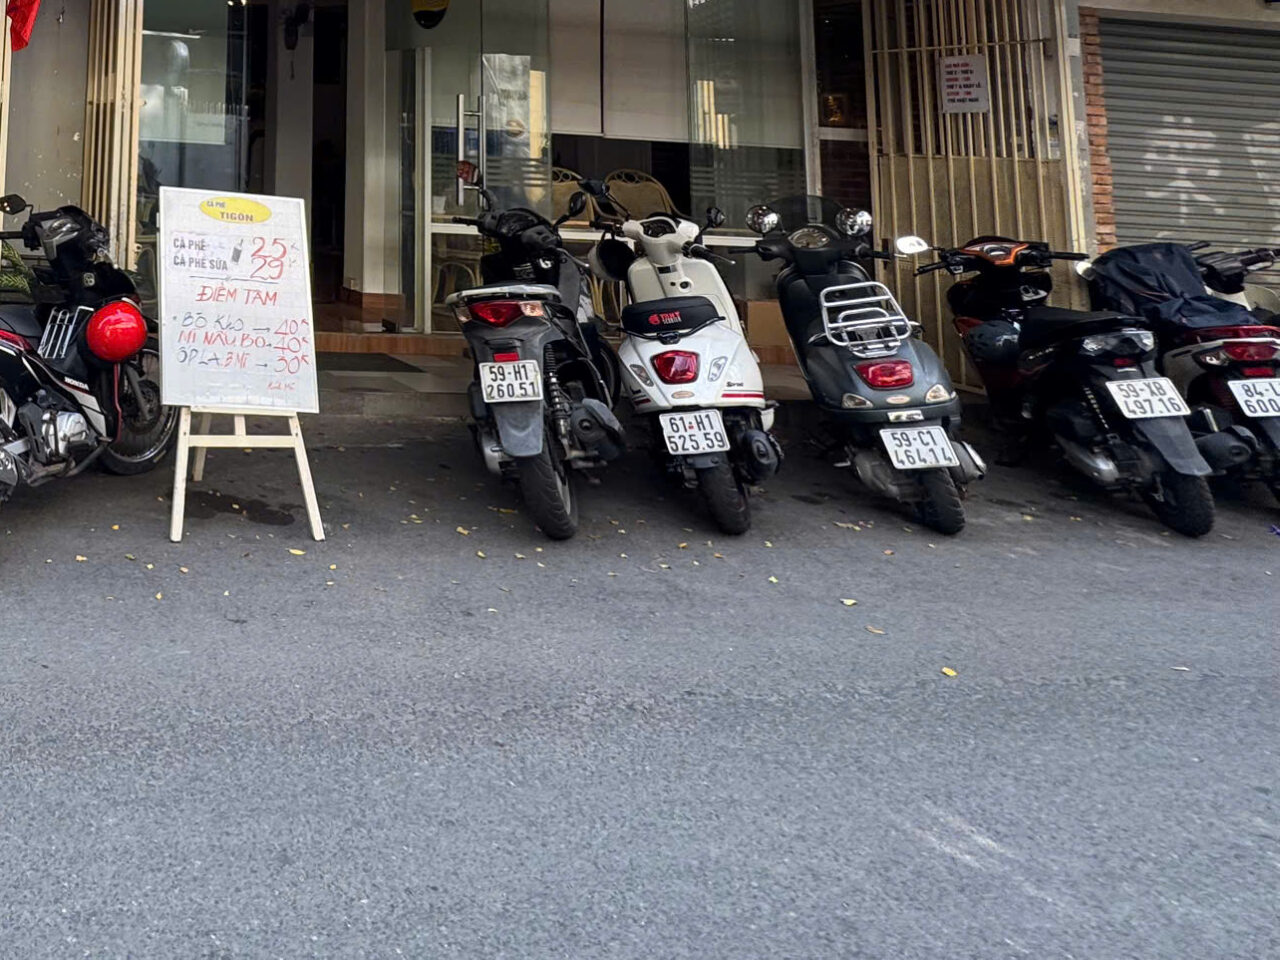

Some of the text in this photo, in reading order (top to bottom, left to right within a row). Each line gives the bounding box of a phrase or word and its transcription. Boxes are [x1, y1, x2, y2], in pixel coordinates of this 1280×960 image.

[250, 236, 287, 259] 25
[249, 256, 284, 280] 29
[488, 364, 529, 382] 59-H1
[64, 376, 90, 391] HONDA
[1123, 397, 1182, 415] 497.16
[668, 413, 714, 433] 61-H1
[667, 431, 725, 452] 525.59
[890, 430, 938, 448] 59-C1
